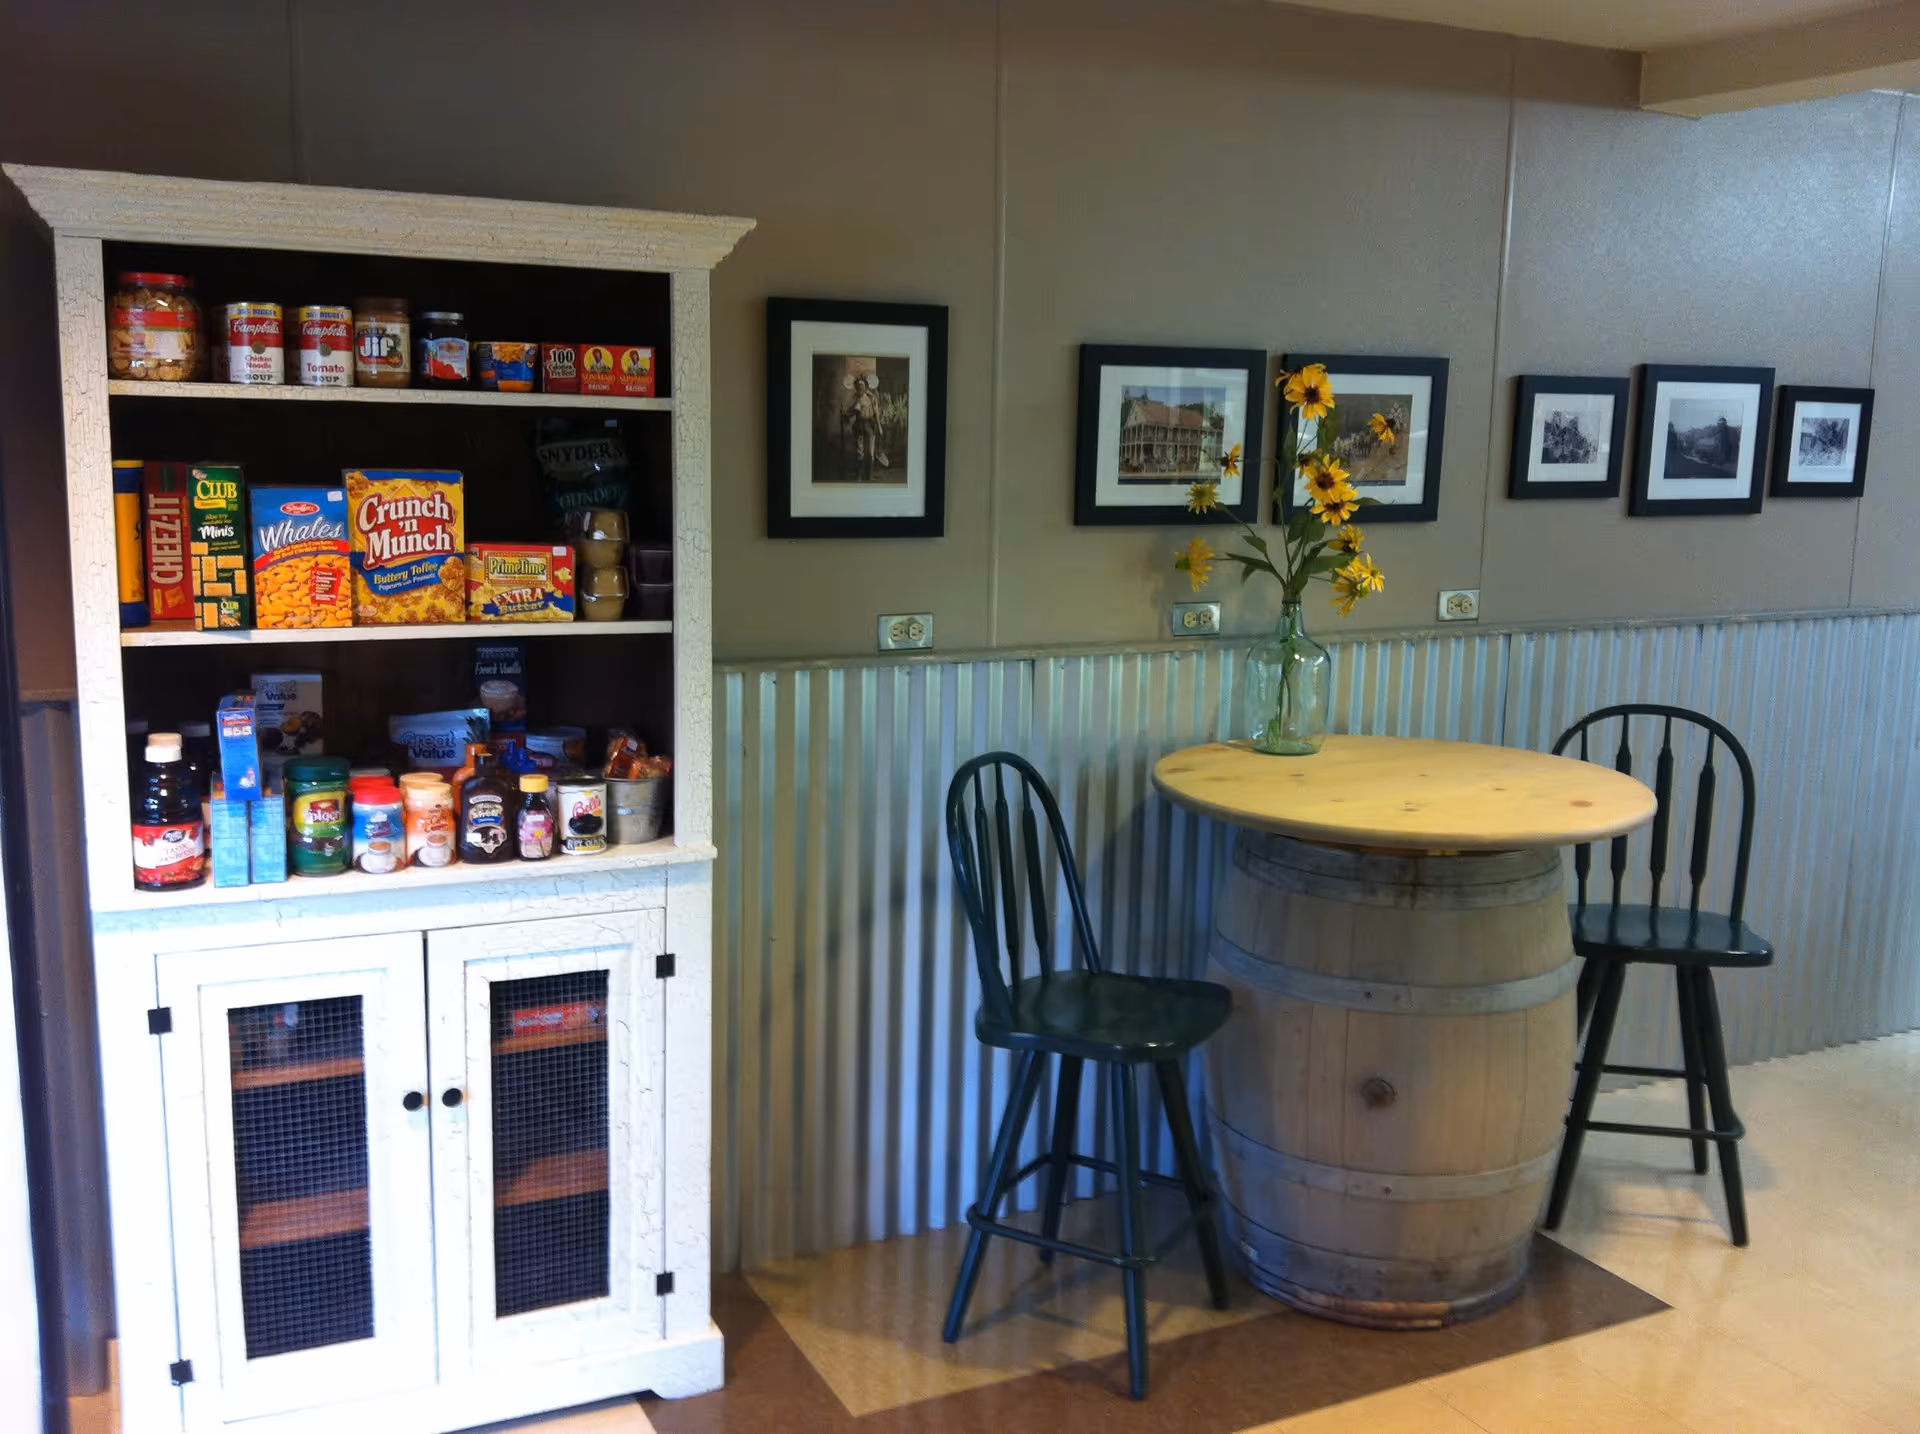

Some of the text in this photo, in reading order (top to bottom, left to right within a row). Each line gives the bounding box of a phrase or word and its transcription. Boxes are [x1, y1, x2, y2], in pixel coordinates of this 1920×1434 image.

[359, 336, 394, 357] Jif
[551, 348, 575, 364] 100
[306, 362, 345, 375] Tomato
[244, 373, 274, 382] SOUP
[311, 374, 341, 384] SOUP
[196, 480, 238, 500] CLUB
[359, 494, 451, 532] Crunch
[148, 494, 183, 584] CHEEZ-IT
[197, 525, 234, 540] Minis
[259, 516, 344, 552] Whales
[366, 524, 452, 565] Munch
[373, 561, 439, 585] Buttery Toffee
[500, 601, 546, 614] Butter
[265, 690, 297, 701] Value
[411, 746, 456, 759] Value
